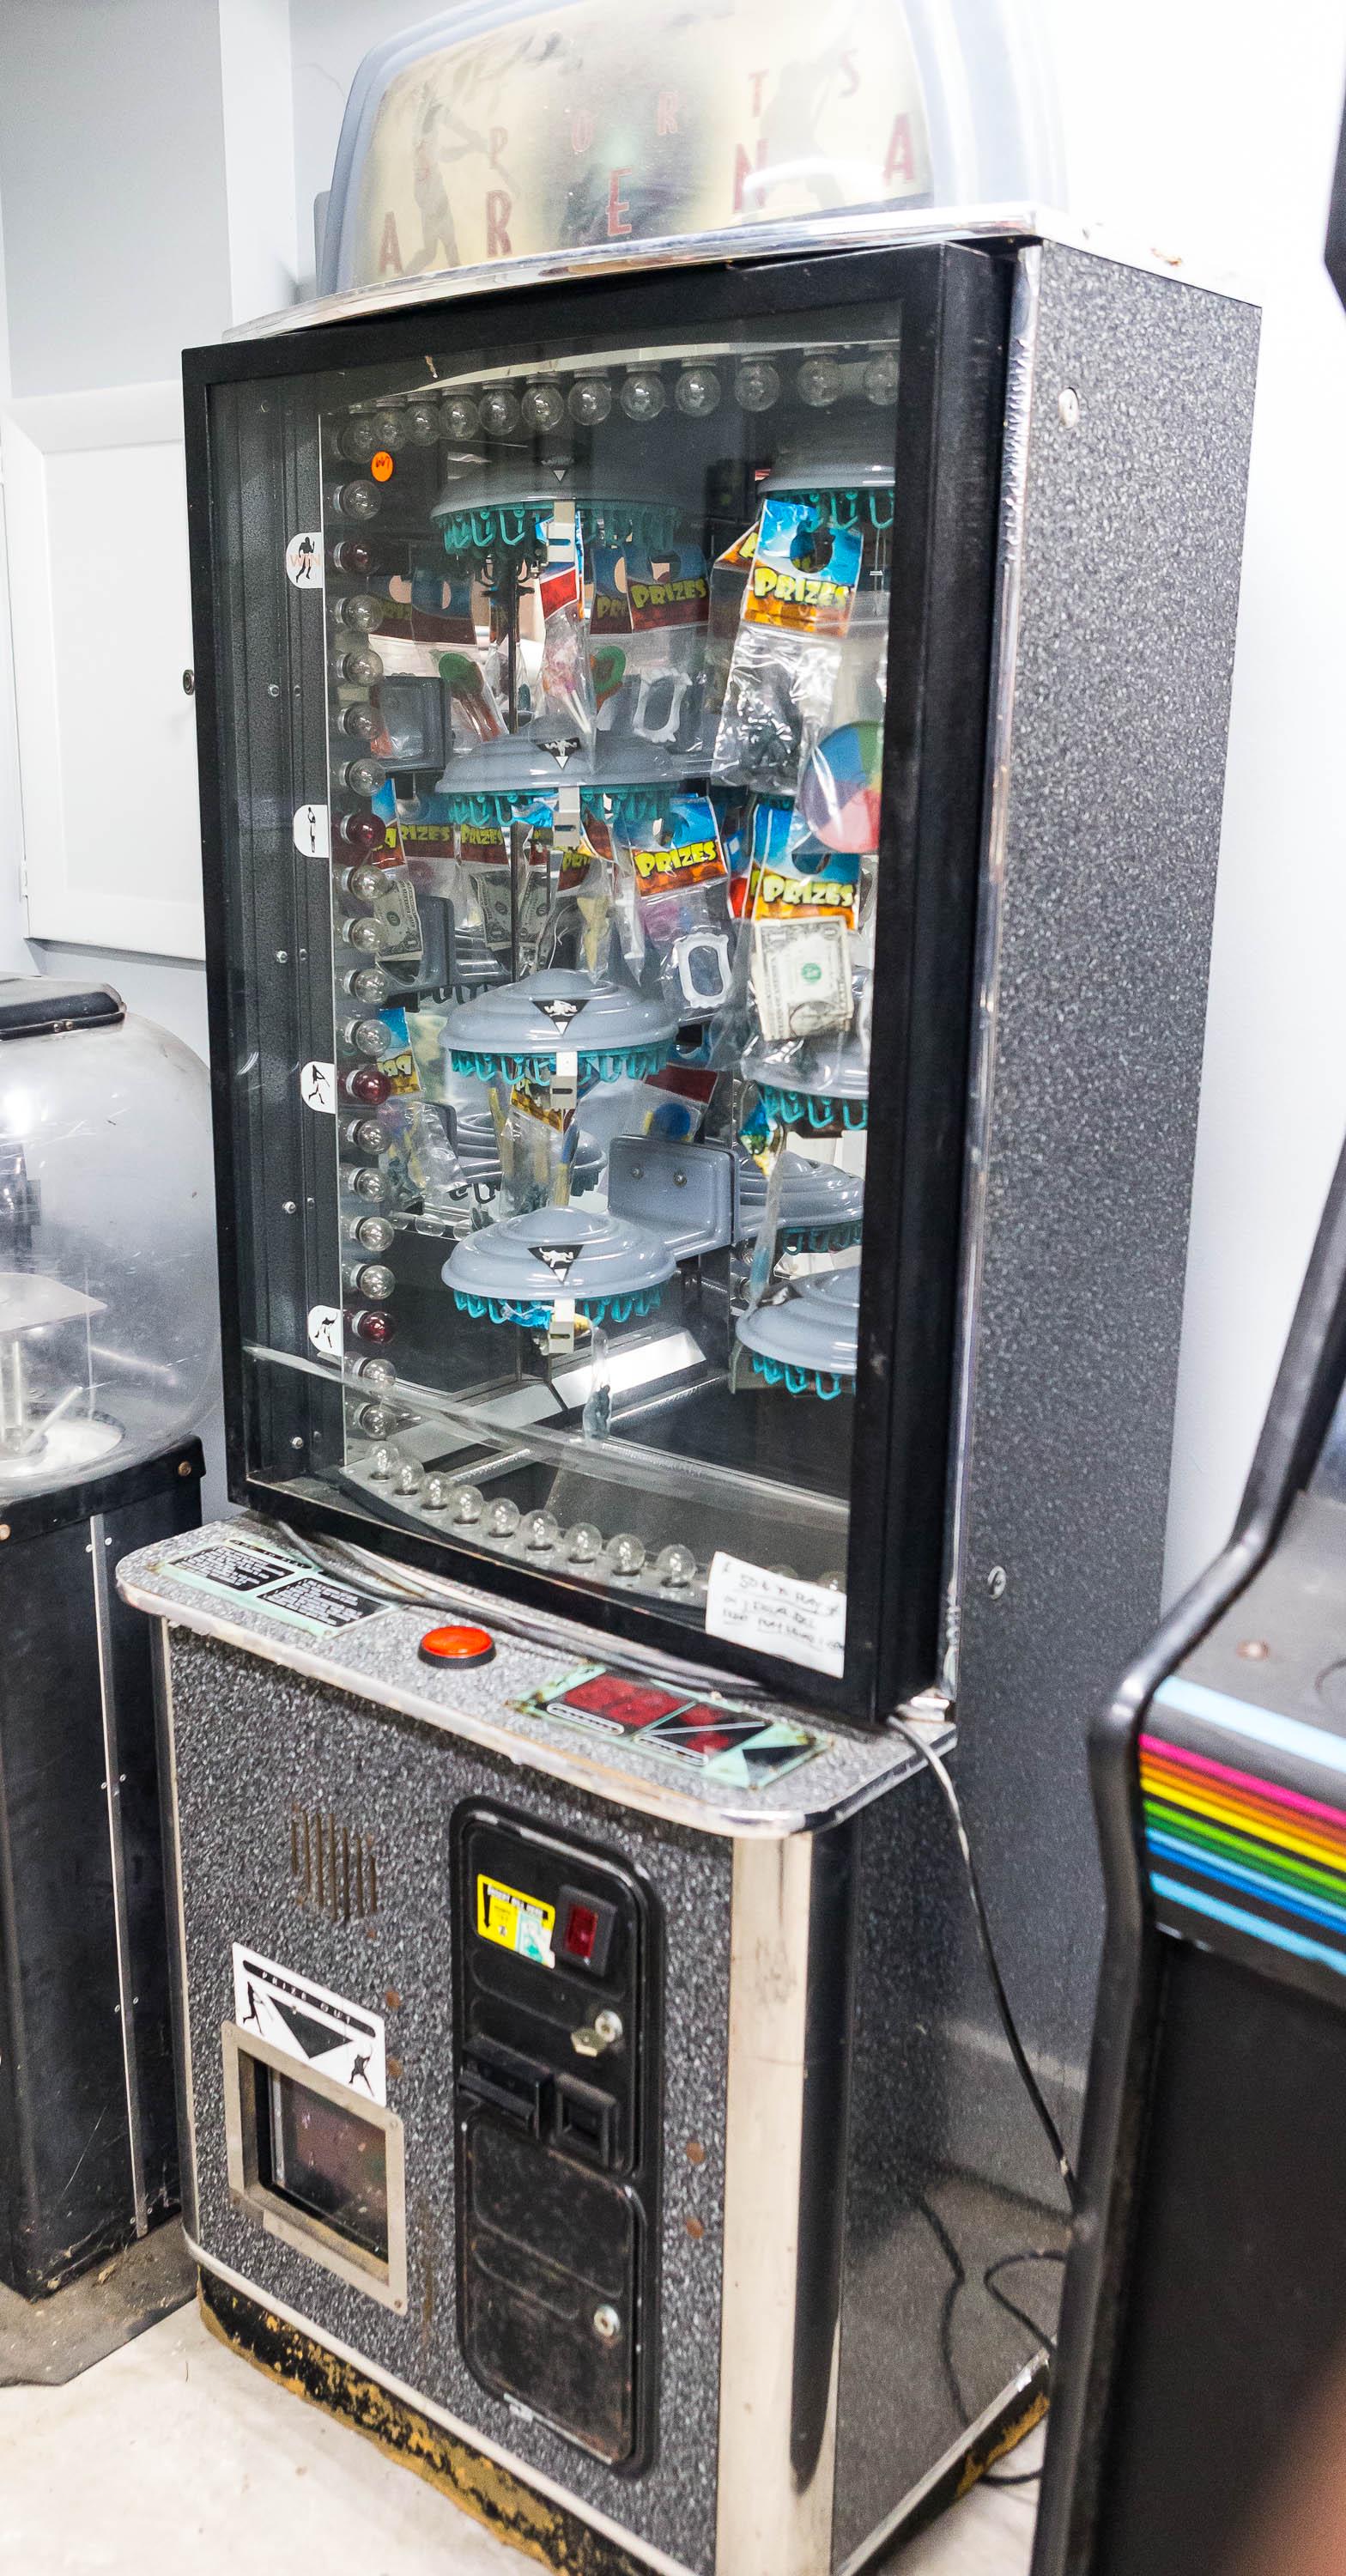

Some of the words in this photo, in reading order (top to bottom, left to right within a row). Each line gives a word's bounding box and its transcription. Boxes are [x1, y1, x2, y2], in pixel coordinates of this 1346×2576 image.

[378, 112, 915, 275] ARENA
[630, 577, 707, 610] PRIZES
[753, 567, 852, 607] PRIZES
[400, 823, 451, 841] RIZES
[634, 840, 718, 878] PRIZES
[762, 873, 856, 907] PRIZES
[261, 1970, 308, 2002] PRIZE
[319, 2002, 352, 2025] OUT
